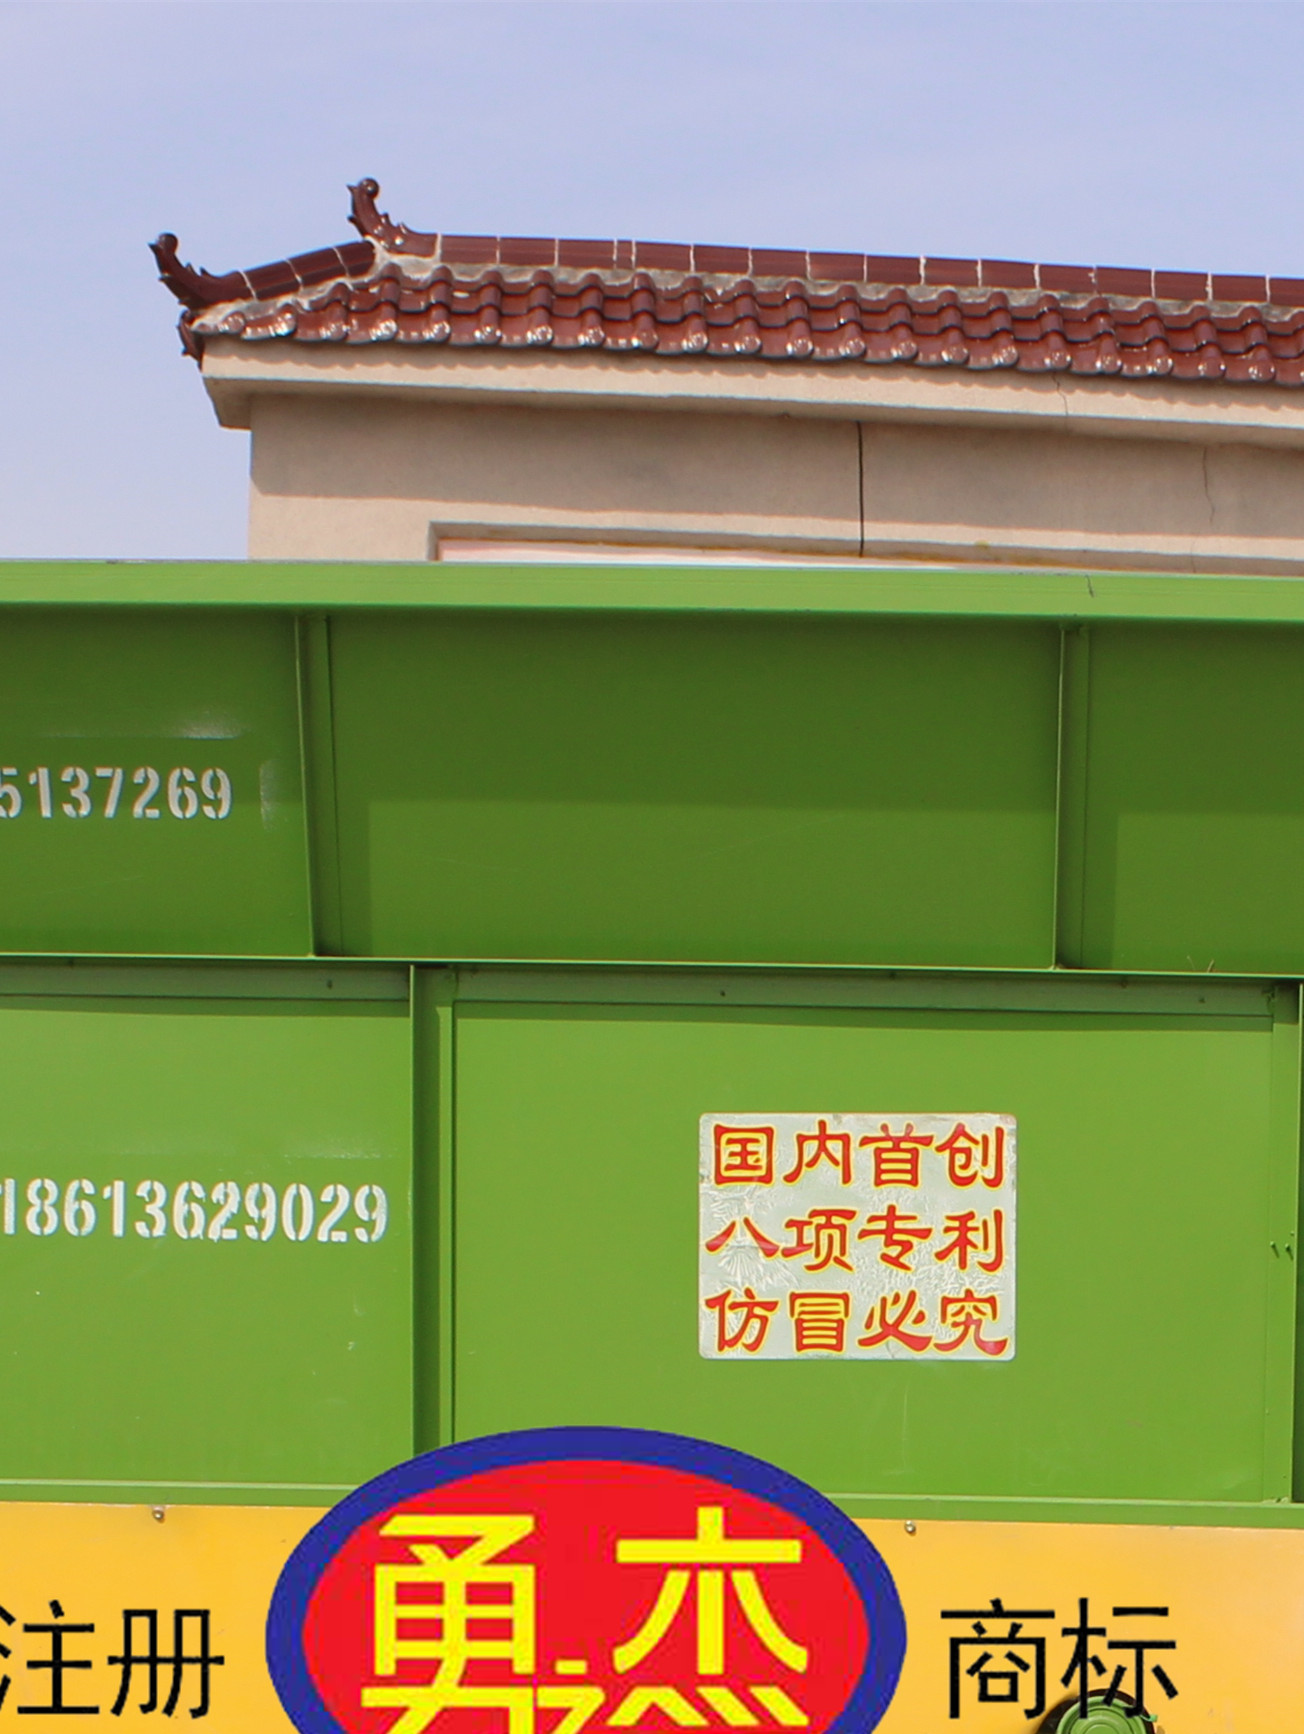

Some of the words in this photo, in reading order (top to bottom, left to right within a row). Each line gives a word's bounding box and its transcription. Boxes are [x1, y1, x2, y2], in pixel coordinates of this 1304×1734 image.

[711, 1119, 1005, 1190] 国内首创
[703, 1203, 1005, 1274] 八项专利
[703, 1286, 1009, 1357] 仿冒必究
